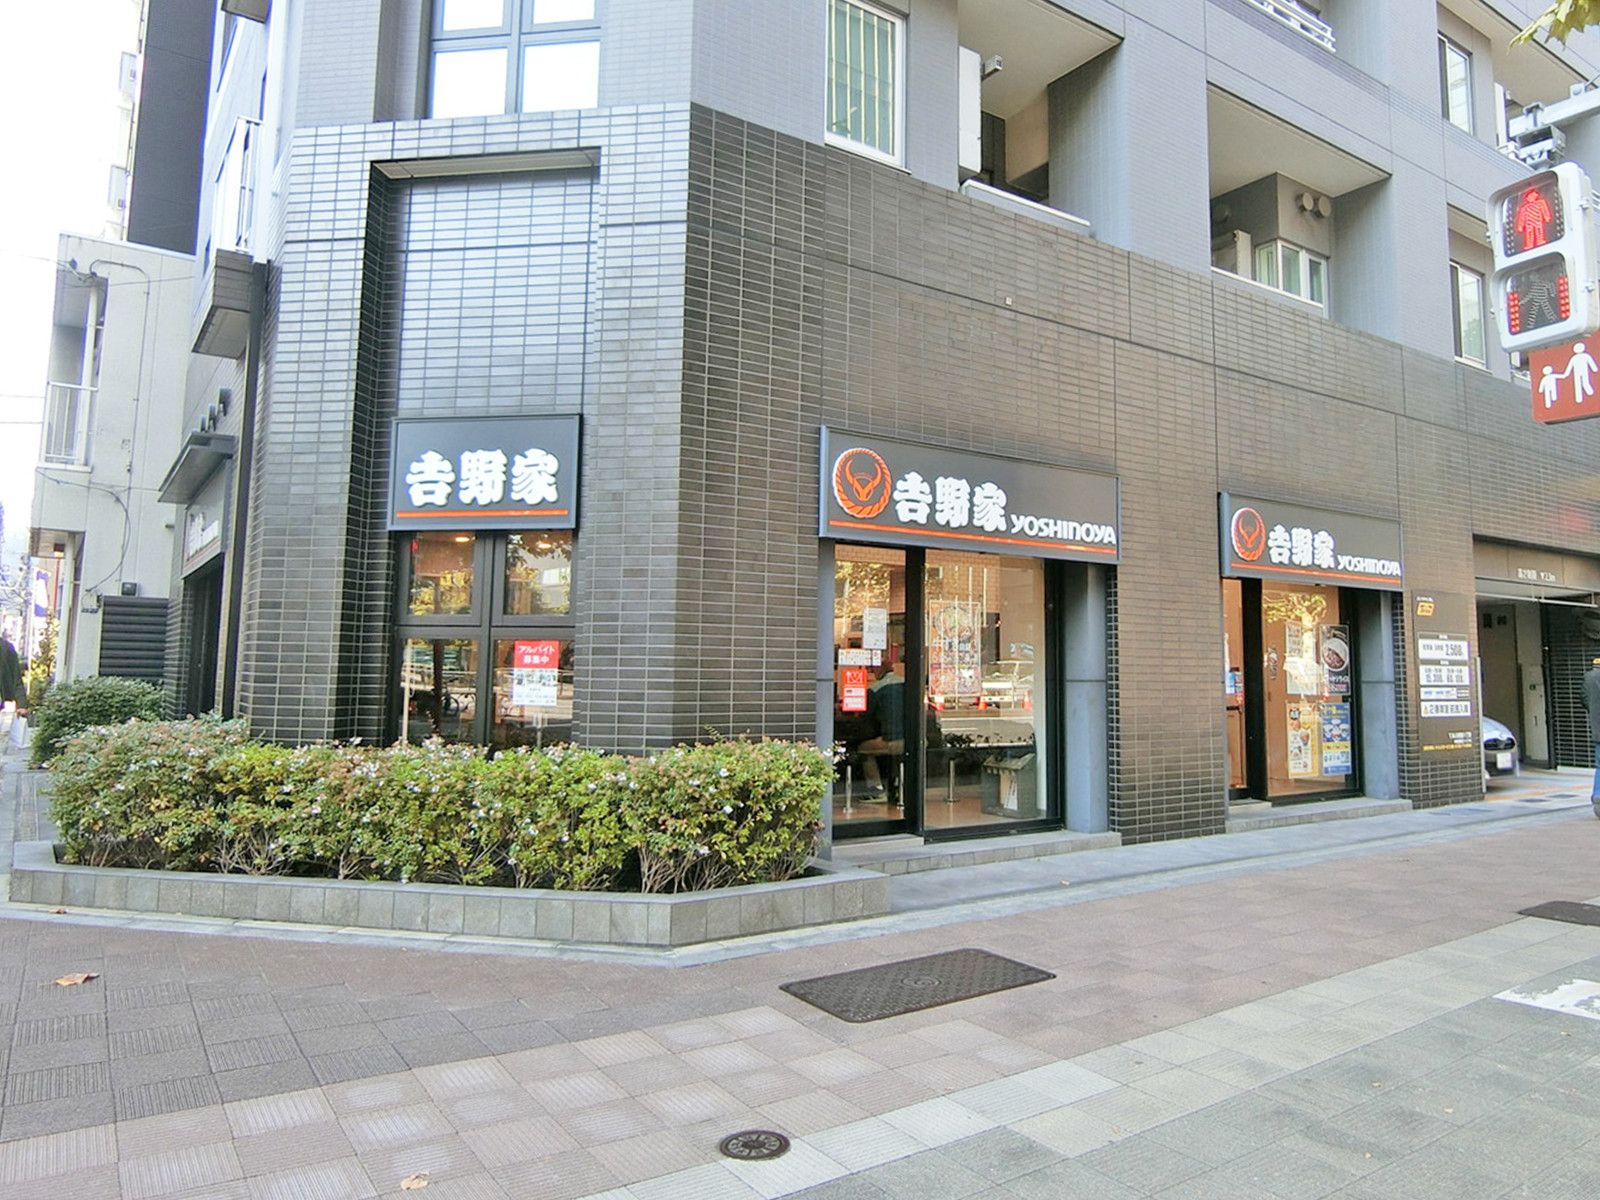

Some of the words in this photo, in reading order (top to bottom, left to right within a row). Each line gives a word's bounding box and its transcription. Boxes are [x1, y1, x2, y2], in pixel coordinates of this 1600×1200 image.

[406, 448, 559, 507] 吉野家
[893, 471, 1007, 532] 吉野家
[1010, 514, 1117, 545] YOSHINOYA
[1267, 524, 1335, 569] 吉野家
[1337, 554, 1402, 577] YOSHINOYA
[518, 645, 555, 655] アルバイト
